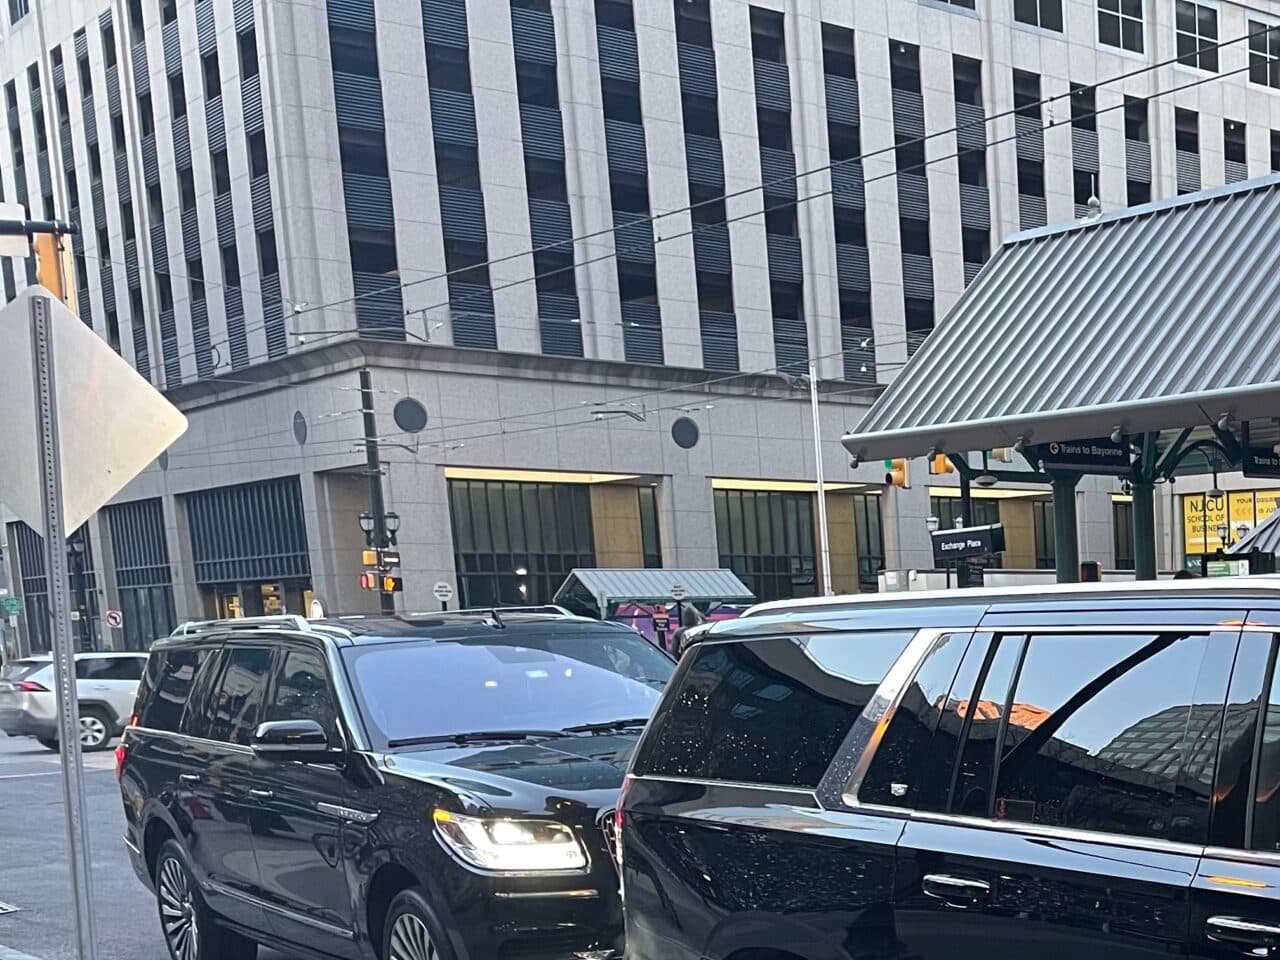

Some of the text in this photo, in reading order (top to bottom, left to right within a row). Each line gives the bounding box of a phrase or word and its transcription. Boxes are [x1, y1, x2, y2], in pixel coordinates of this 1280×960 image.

[1059, 444, 1123, 457] Trains to Bayonne
[1190, 497, 1224, 513] NJCU
[1215, 513, 1225, 522] OF
[941, 539, 982, 551] Exchange Place
